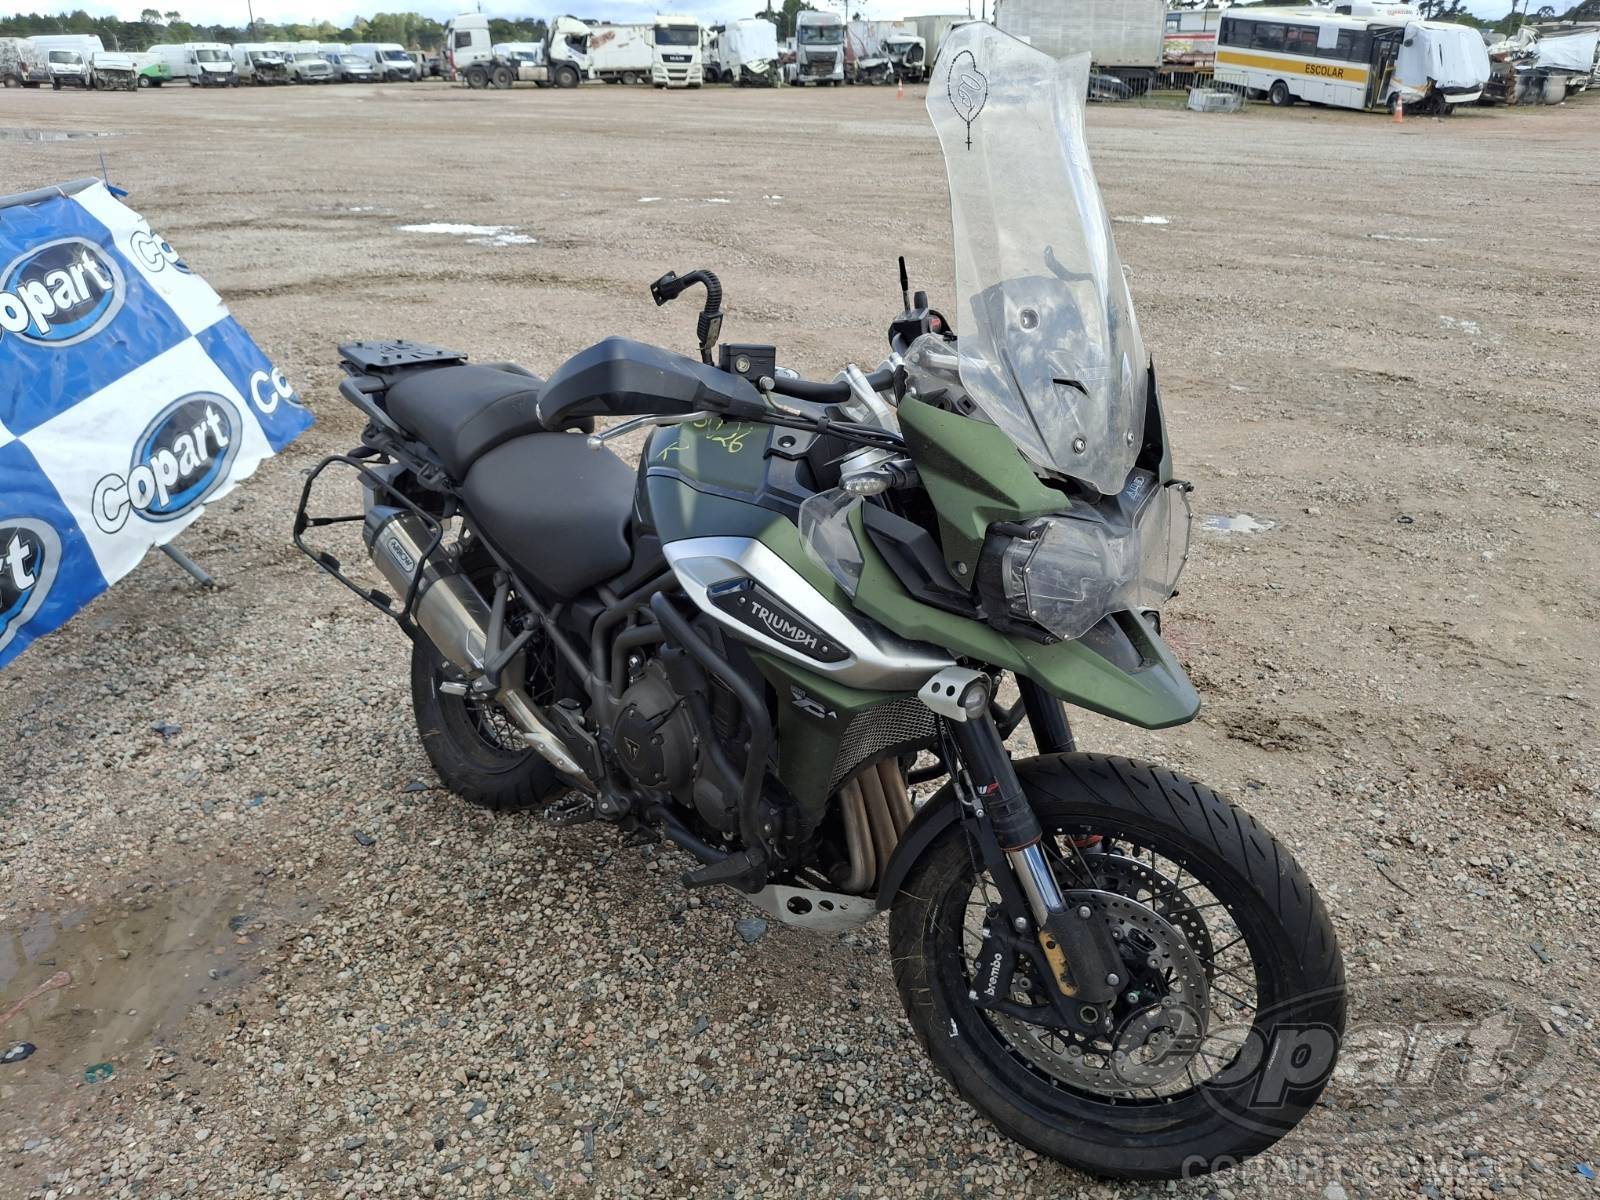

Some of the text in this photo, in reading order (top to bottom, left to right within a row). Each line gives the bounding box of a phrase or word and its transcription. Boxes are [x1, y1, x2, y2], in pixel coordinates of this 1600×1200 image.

[1305, 63, 1344, 78] ESCOLAR
[0, 248, 114, 336] opart
[91, 404, 230, 535] Copart
[752, 601, 818, 649] TRIUMPH
[983, 952, 1003, 997] brembo
